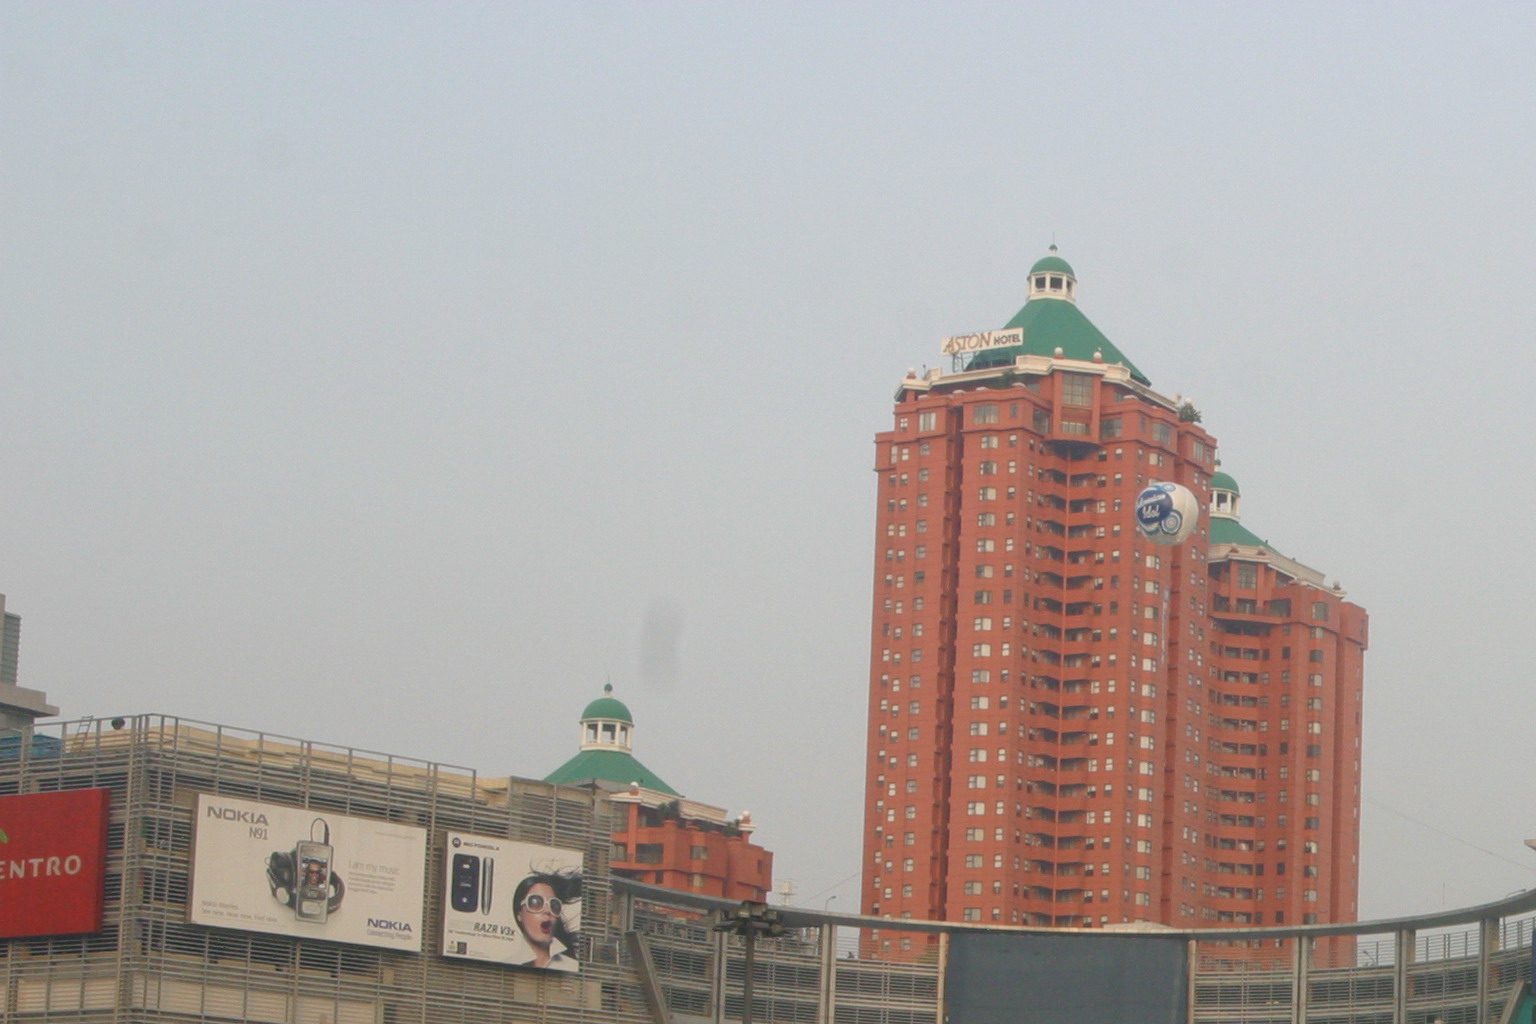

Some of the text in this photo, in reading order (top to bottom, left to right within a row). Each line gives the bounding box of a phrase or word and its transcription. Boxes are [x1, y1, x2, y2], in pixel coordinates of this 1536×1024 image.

[943, 332, 1021, 353] ASTON HOTEL
[207, 806, 269, 826] NOKIA
[249, 826, 268, 840] N91
[367, 918, 412, 932] NOKIA
[474, 922, 499, 934] RAZR
[500, 926, 515, 936] V3x
